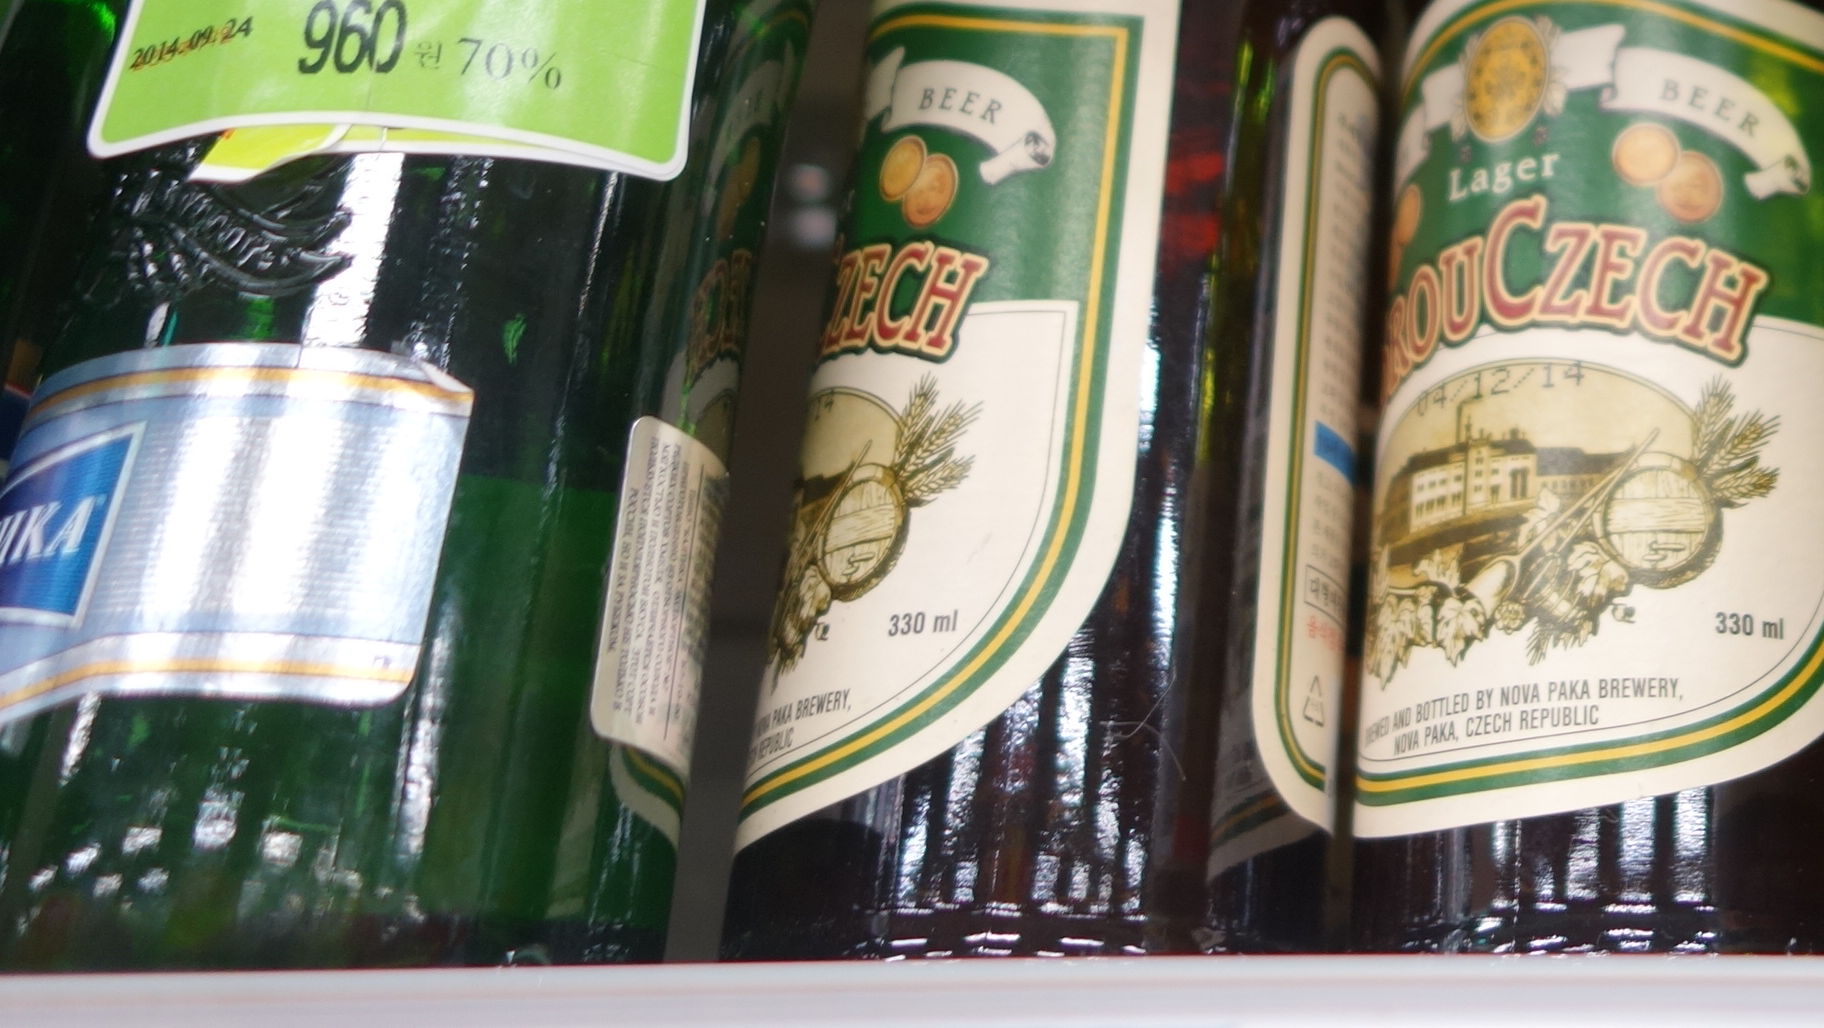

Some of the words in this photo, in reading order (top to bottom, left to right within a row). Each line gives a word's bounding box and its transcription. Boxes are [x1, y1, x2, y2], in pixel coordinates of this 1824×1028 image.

[456, 36, 563, 90] 70%
[916, 84, 1005, 127] BEER
[1659, 77, 1763, 139] BEER
[1448, 151, 1561, 203] Lager
[888, 610, 926, 637] 330
[932, 609, 959, 634] ml
[1716, 611, 1758, 637] 330
[1762, 617, 1785, 641] ml
[795, 687, 852, 721] BREWERY,
[1392, 707, 1412, 730] AND
[1415, 692, 1470, 726] BOTTLED
[1475, 690, 1493, 711] BY
[1500, 682, 1541, 708] NOVA
[1547, 679, 1590, 703] PAKA
[1597, 676, 1685, 702] BREWERY,
[1393, 729, 1420, 757] NOVA
[1424, 722, 1460, 747] PAKA,
[1465, 711, 1513, 739] CZECH
[1519, 704, 1601, 732] REPUBLIC
